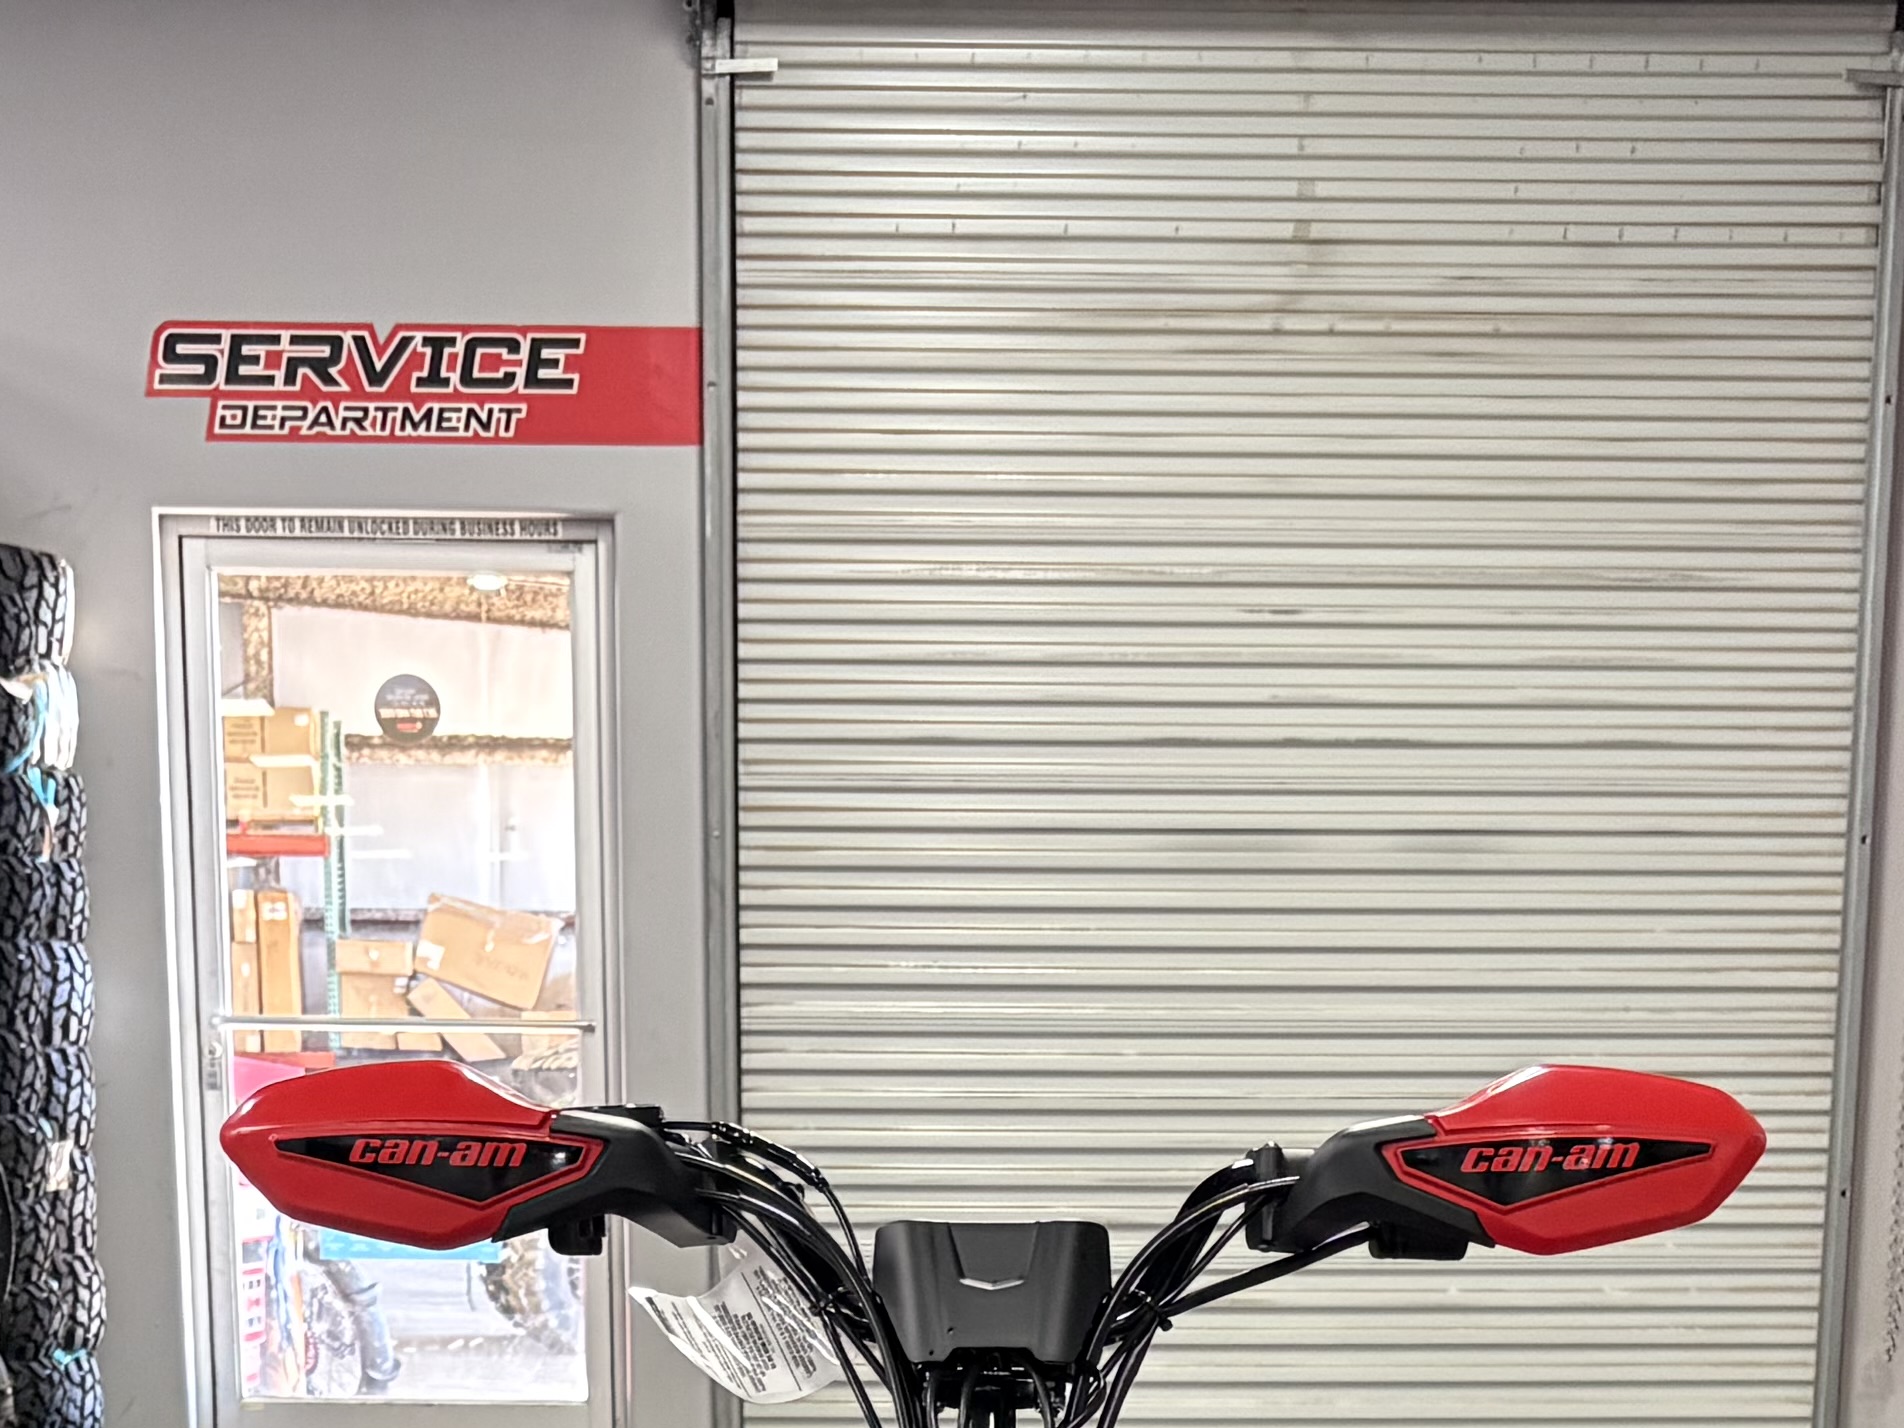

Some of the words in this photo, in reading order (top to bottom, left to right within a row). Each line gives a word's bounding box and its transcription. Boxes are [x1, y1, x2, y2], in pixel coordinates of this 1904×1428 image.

[156, 331, 583, 393] SERVICE
[217, 403, 522, 435] DEPARTMENT
[214, 517, 242, 533] THIS
[246, 517, 277, 534] DOOR
[280, 518, 296, 534] TO
[299, 518, 345, 534] REMAIN
[348, 518, 409, 536] UNLOCKED
[413, 519, 456, 536] DURING
[459, 519, 516, 537] BUSINESS
[520, 520, 559, 537] HOURS
[348, 1137, 527, 1168] can-am
[1460, 1142, 1641, 1174] can-am
